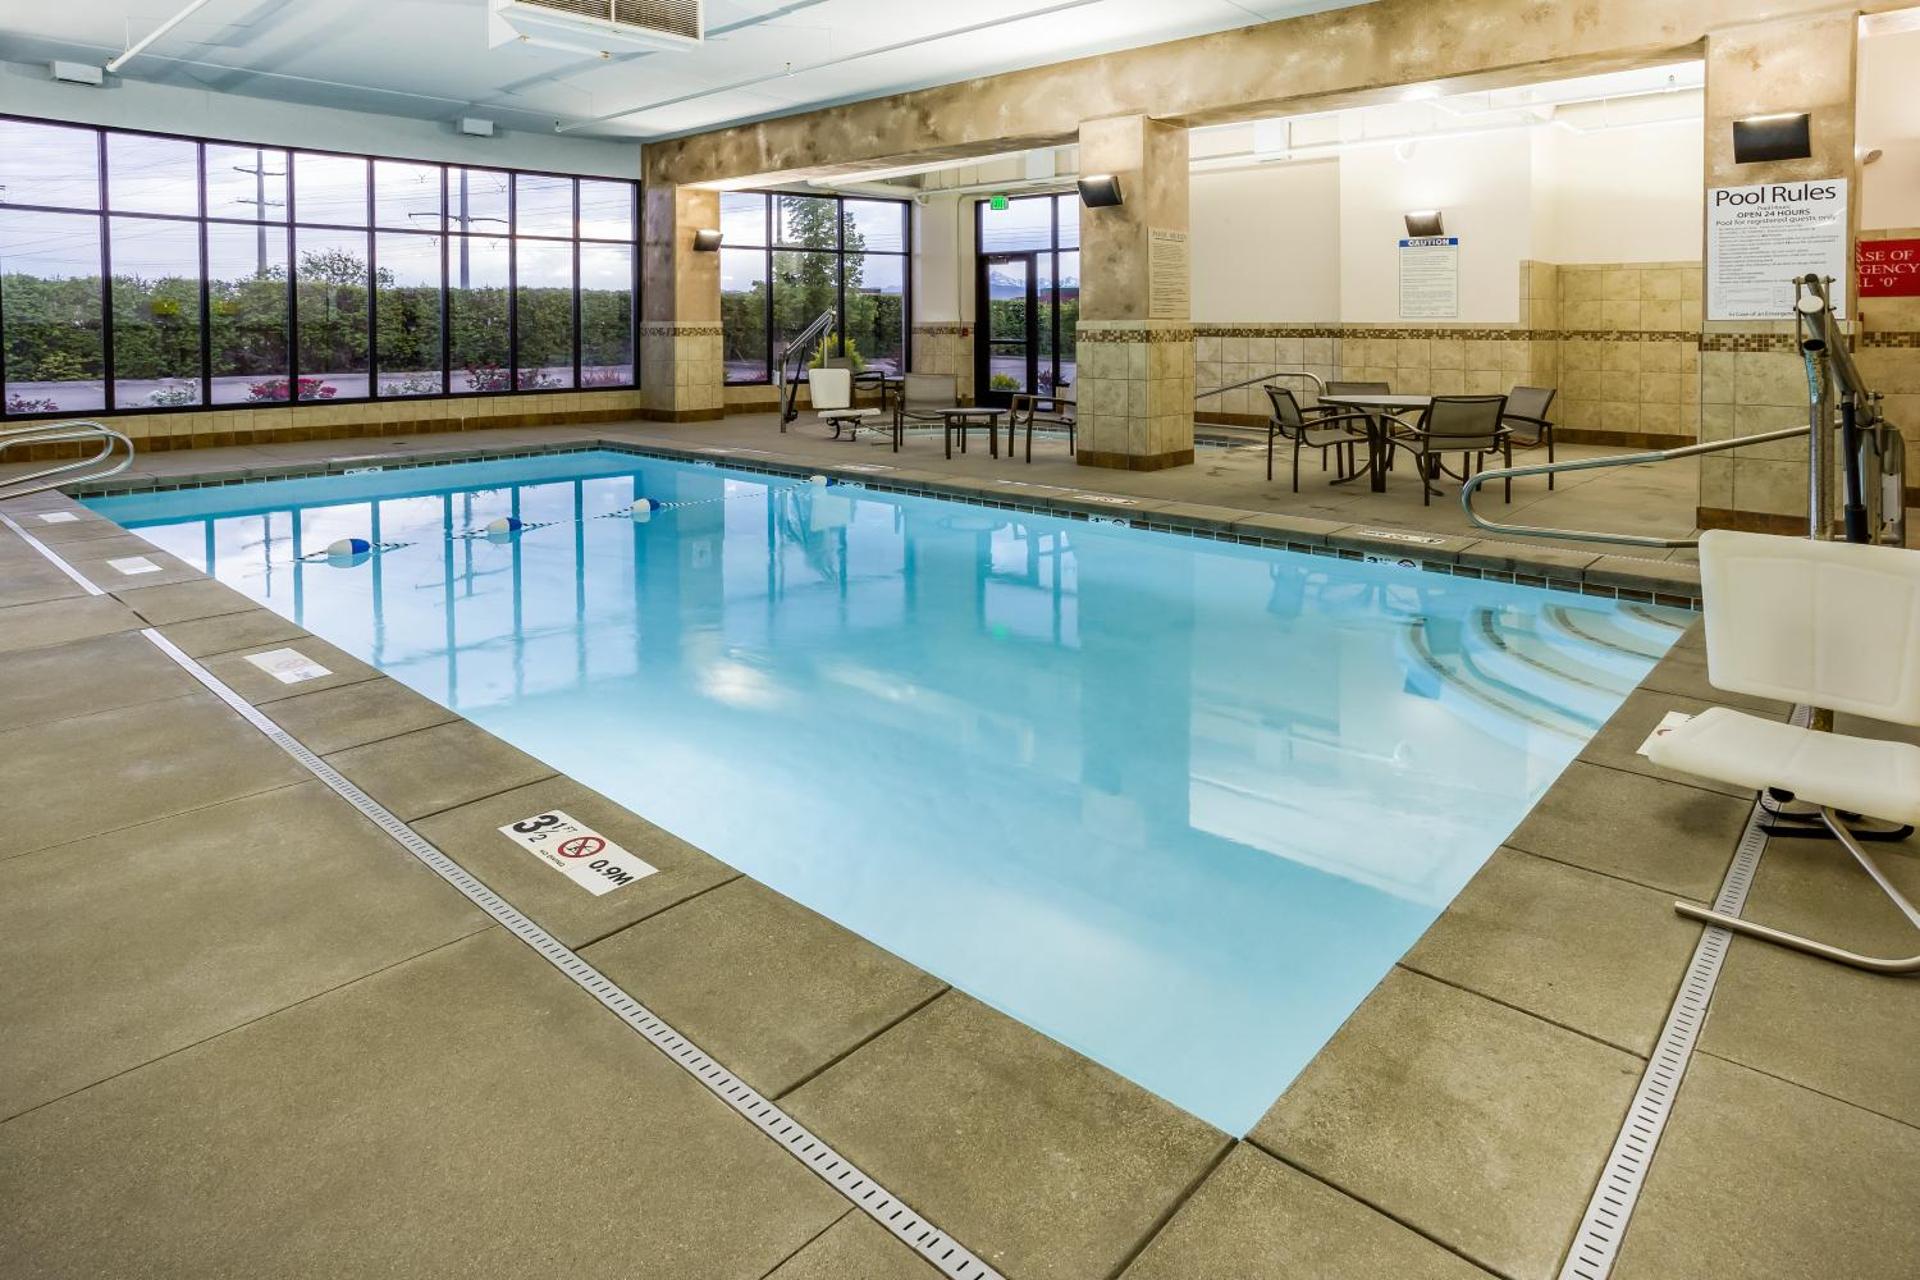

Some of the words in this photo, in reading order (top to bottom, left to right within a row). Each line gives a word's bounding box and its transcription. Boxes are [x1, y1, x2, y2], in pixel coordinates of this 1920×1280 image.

[1716, 187, 1765, 206] Pool
[1772, 184, 1836, 202] Rules
[1746, 217, 1788, 226] registered
[1408, 239, 1449, 247] CAUTION
[1890, 250, 1914, 261] OF
[589, 860, 634, 886] 0.9M
